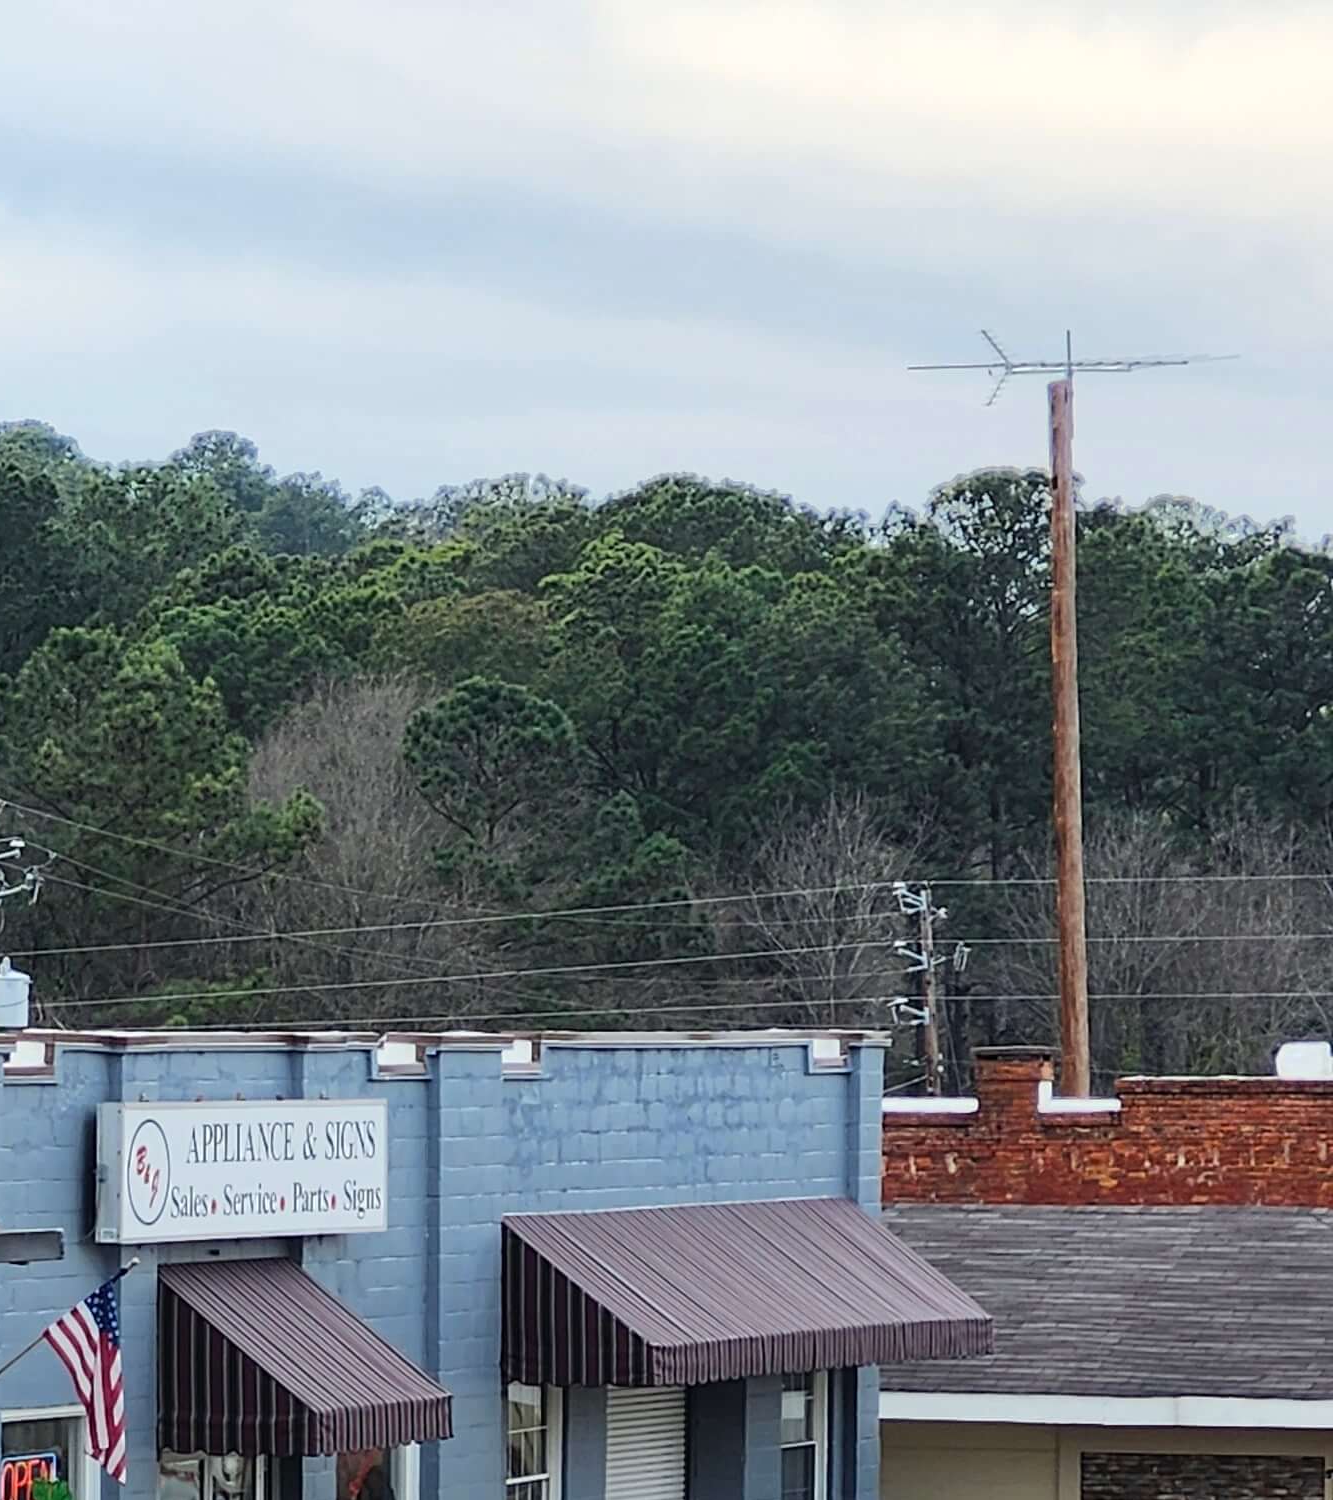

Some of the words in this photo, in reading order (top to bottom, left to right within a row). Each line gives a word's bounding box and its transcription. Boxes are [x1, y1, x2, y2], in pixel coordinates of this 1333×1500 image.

[186, 1122, 294, 1164] APPLIANCE
[303, 1121, 317, 1161] &
[324, 1119, 376, 1161] SIGNS
[170, 1185, 209, 1219] Sales
[223, 1183, 277, 1216] Service
[292, 1181, 330, 1213] Parts
[343, 1179, 382, 1220] Signs
